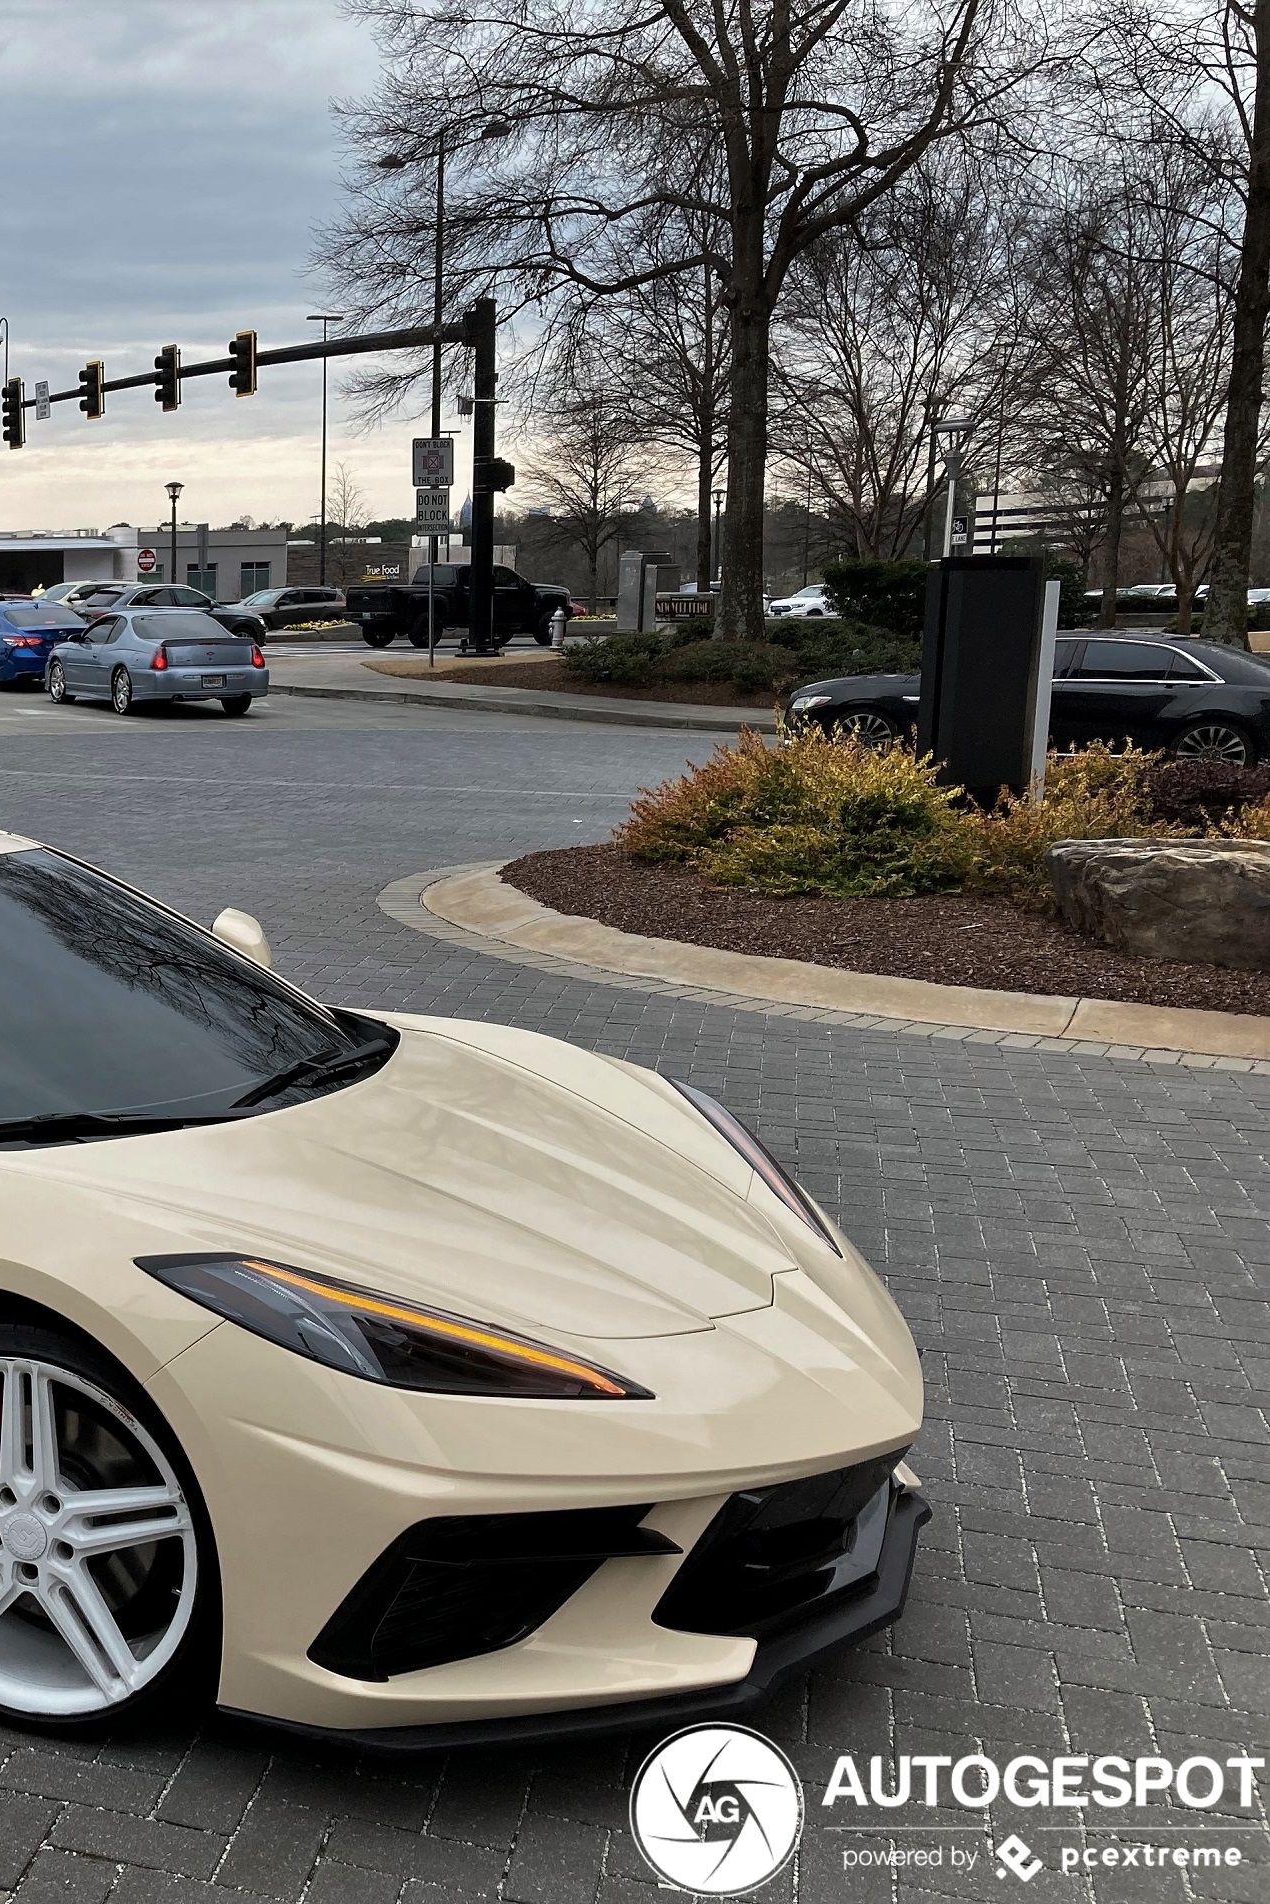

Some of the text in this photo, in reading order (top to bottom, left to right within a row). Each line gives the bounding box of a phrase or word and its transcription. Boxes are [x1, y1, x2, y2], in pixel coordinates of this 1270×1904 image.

[415, 441, 431, 449] DON'T
[417, 476, 449, 484] THE BOX
[418, 495, 448, 506] DO NOT
[418, 510, 448, 521] BLOCK
[418, 523, 448, 532] INTERSECTION
[365, 564, 400, 575] True Food
